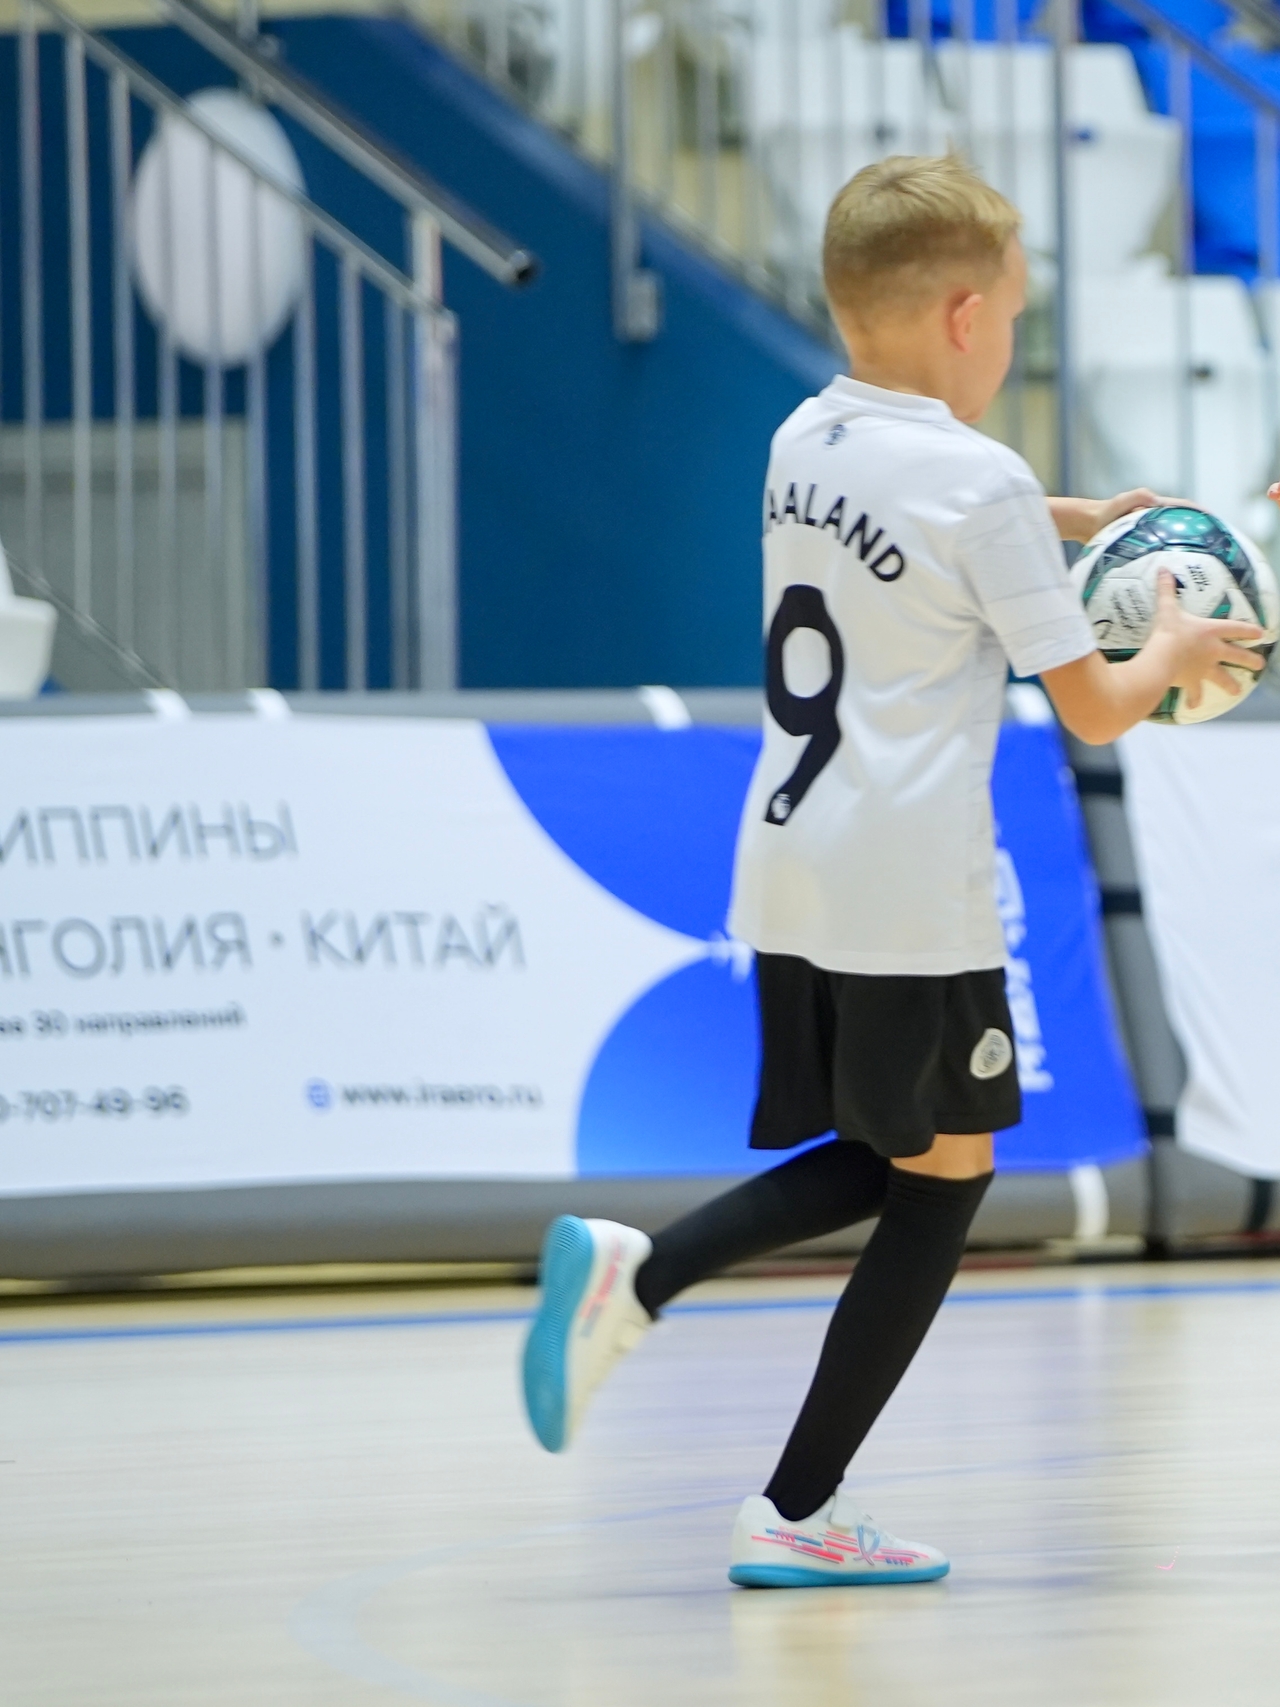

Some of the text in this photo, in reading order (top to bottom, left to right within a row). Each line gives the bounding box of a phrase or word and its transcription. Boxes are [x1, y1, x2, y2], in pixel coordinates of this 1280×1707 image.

[764, 583, 845, 827] 9
[0, 899, 527, 980] ГОЛИЯ КИТАЙ
[31, 1009, 68, 1038] 30
[74, 1001, 247, 1038] направлений
